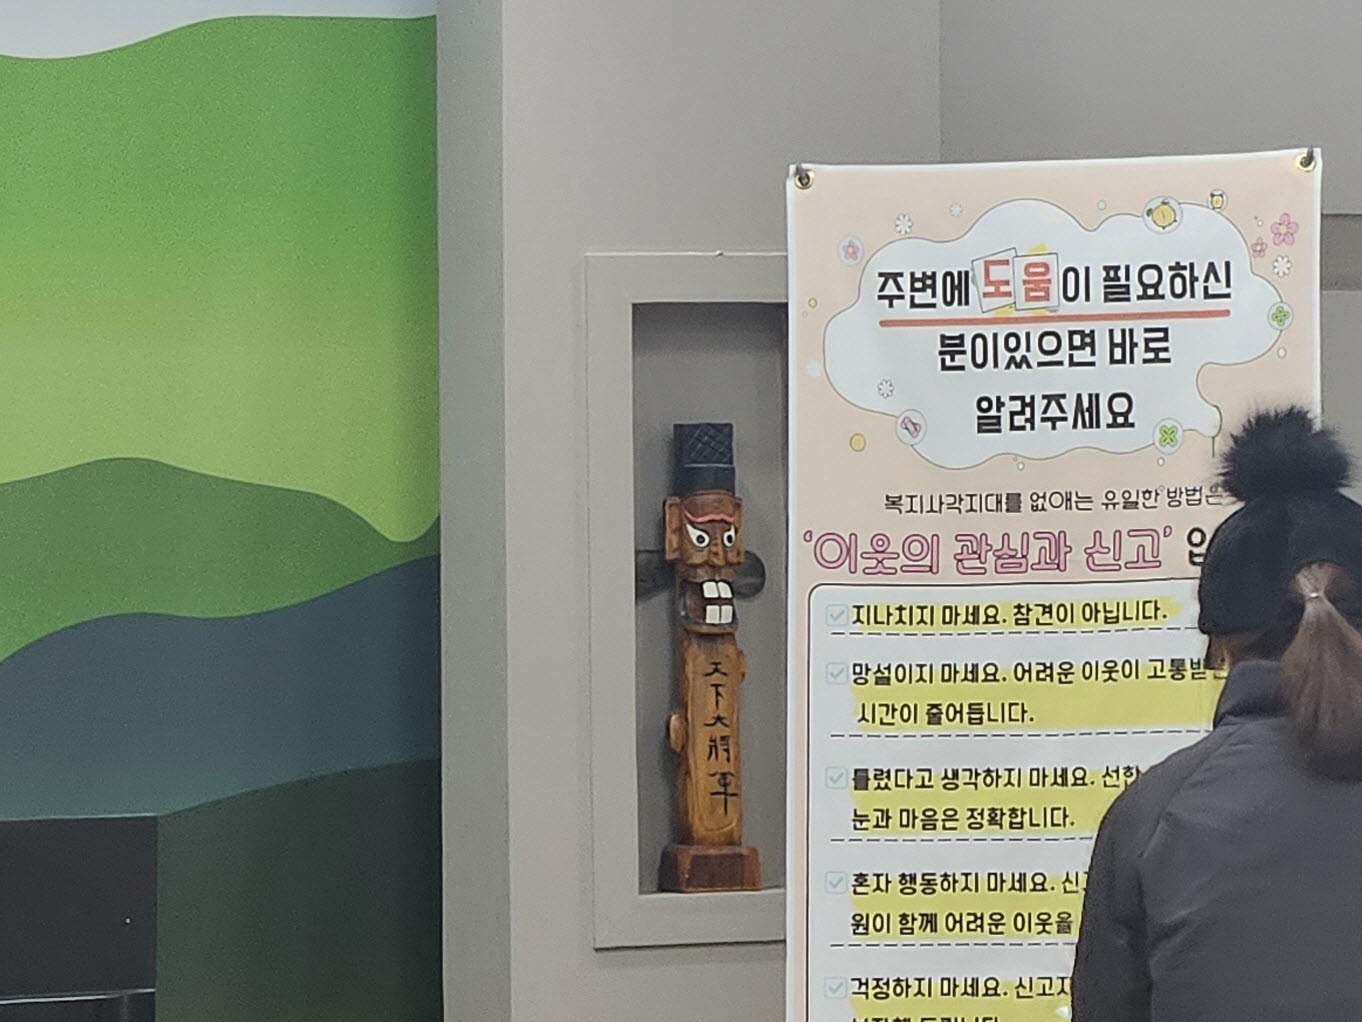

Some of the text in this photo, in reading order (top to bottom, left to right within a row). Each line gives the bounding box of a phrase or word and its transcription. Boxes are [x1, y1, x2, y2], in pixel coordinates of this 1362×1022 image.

[877, 252, 1232, 309] 주변에 도움이 필요하신
[938, 326, 1172, 372] 분이있으면 바로
[976, 392, 1136, 434] 알려주세요
[884, 492, 1023, 515] 복지사각지대를
[1029, 490, 1094, 513] 없애는
[1101, 488, 1160, 511] 유일한
[953, 530, 1073, 576] 관심과
[852, 599, 1168, 627] 지나치지 마세요. 참견이 아닙니다.
[852, 662, 934, 686] 망설이지
[940, 662, 1007, 684] 마세요.
[1013, 661, 1075, 685] 어려운
[1081, 658, 1140, 683] 이웃이
[857, 702, 1034, 727] 시간이 줄어듭니다.
[852, 768, 935, 791] 틀렸다고
[940, 767, 1022, 791] 생각하지
[1029, 766, 1095, 788] 마세요.
[851, 806, 1075, 831] 눈과 마음은 정확합니다.
[851, 872, 893, 896] 혼자
[898, 871, 979, 896] 행동하지
[987, 872, 1055, 893] 마세요.
[850, 911, 1073, 936] 원이 함께 어려운 이웃을
[850, 976, 932, 1001] 걱정하지
[940, 976, 1008, 998] 마세요.
